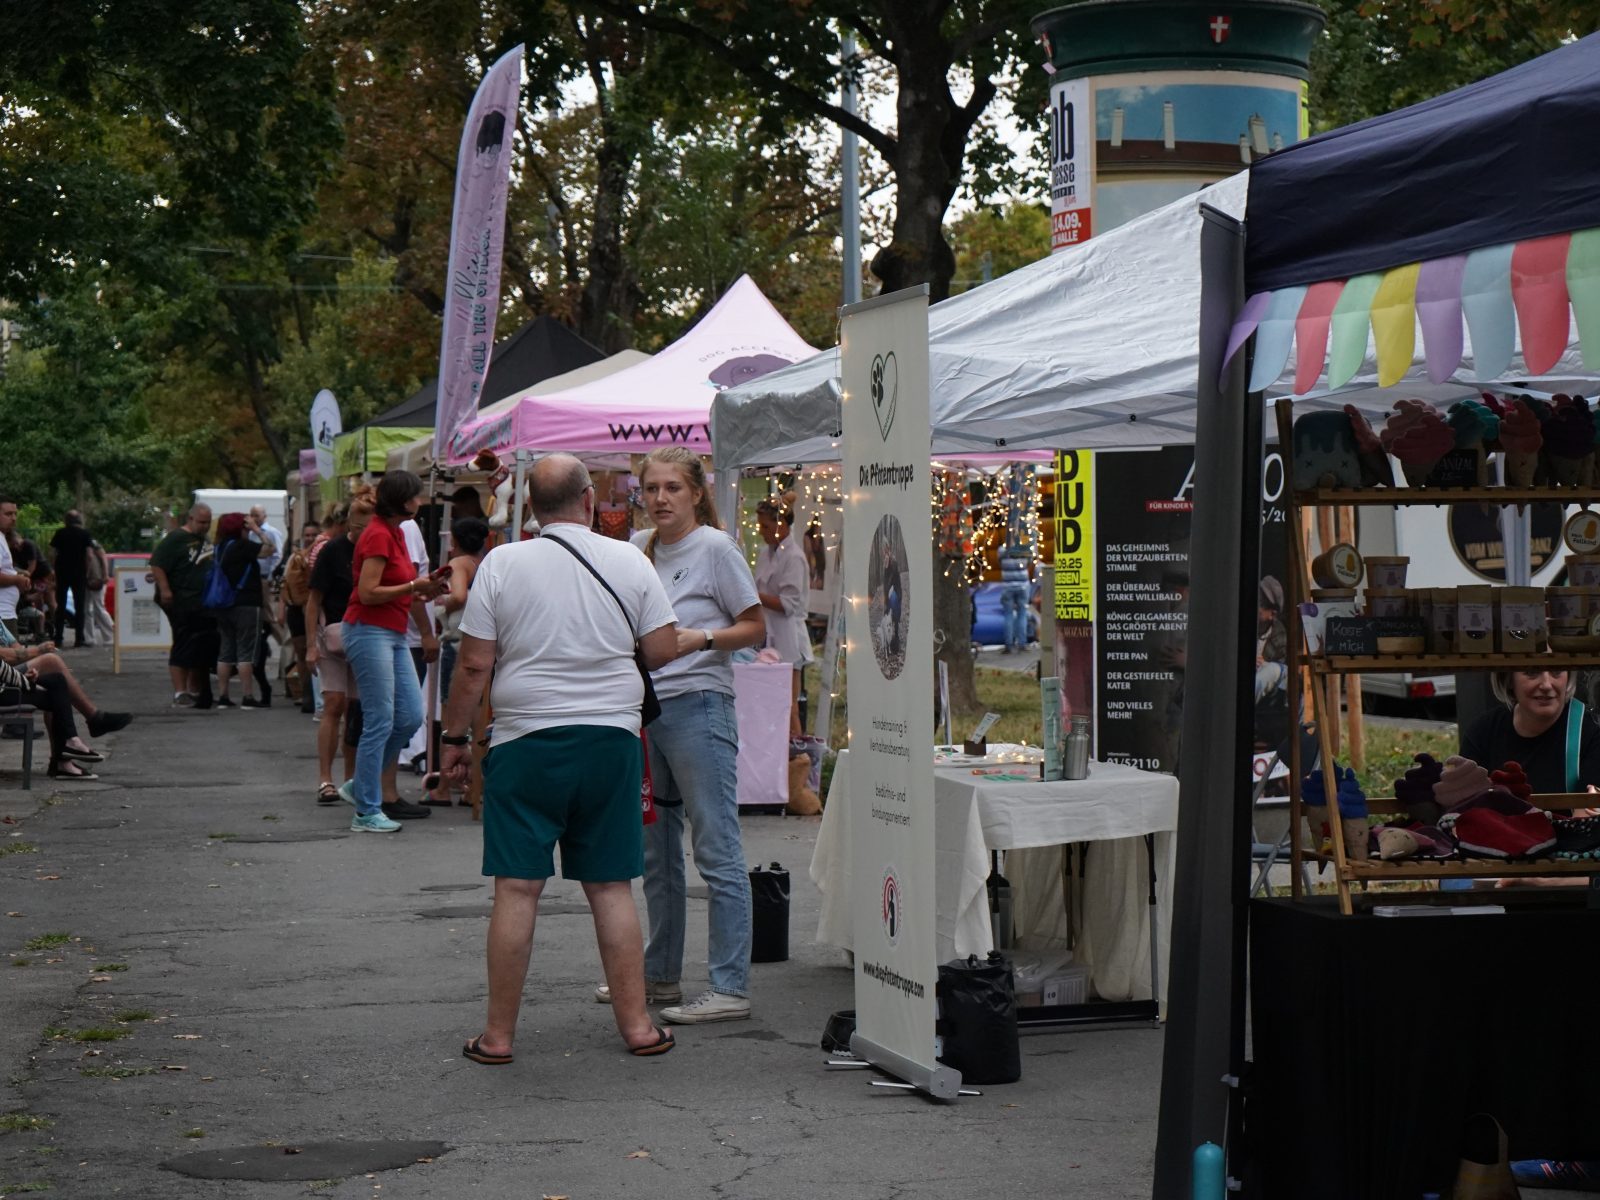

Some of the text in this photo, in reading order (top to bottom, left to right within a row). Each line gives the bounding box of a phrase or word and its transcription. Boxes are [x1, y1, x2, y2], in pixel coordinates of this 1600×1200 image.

[1106, 543, 1170, 552] DAS GEHEIMNIS
[1106, 553, 1188, 562] DER VERZAUBERTEN
[1106, 563, 1137, 572] STIMME
[1106, 581, 1161, 591] DER ÜBERAUS
[1106, 593, 1183, 601] STARKE WILLIBALD
[1106, 610, 1132, 621] KÖNIG
[1106, 622, 1121, 631] DAS
[1158, 622, 1188, 631] ABENT
[1106, 632, 1145, 641] DER WELT
[1106, 652, 1149, 661] PETER PAN
[1106, 671, 1175, 680] DER GESTIEFELTE
[1106, 681, 1131, 690] KATER
[1106, 701, 1154, 710] UND VIELES
[1106, 711, 1133, 720] MEHR!
